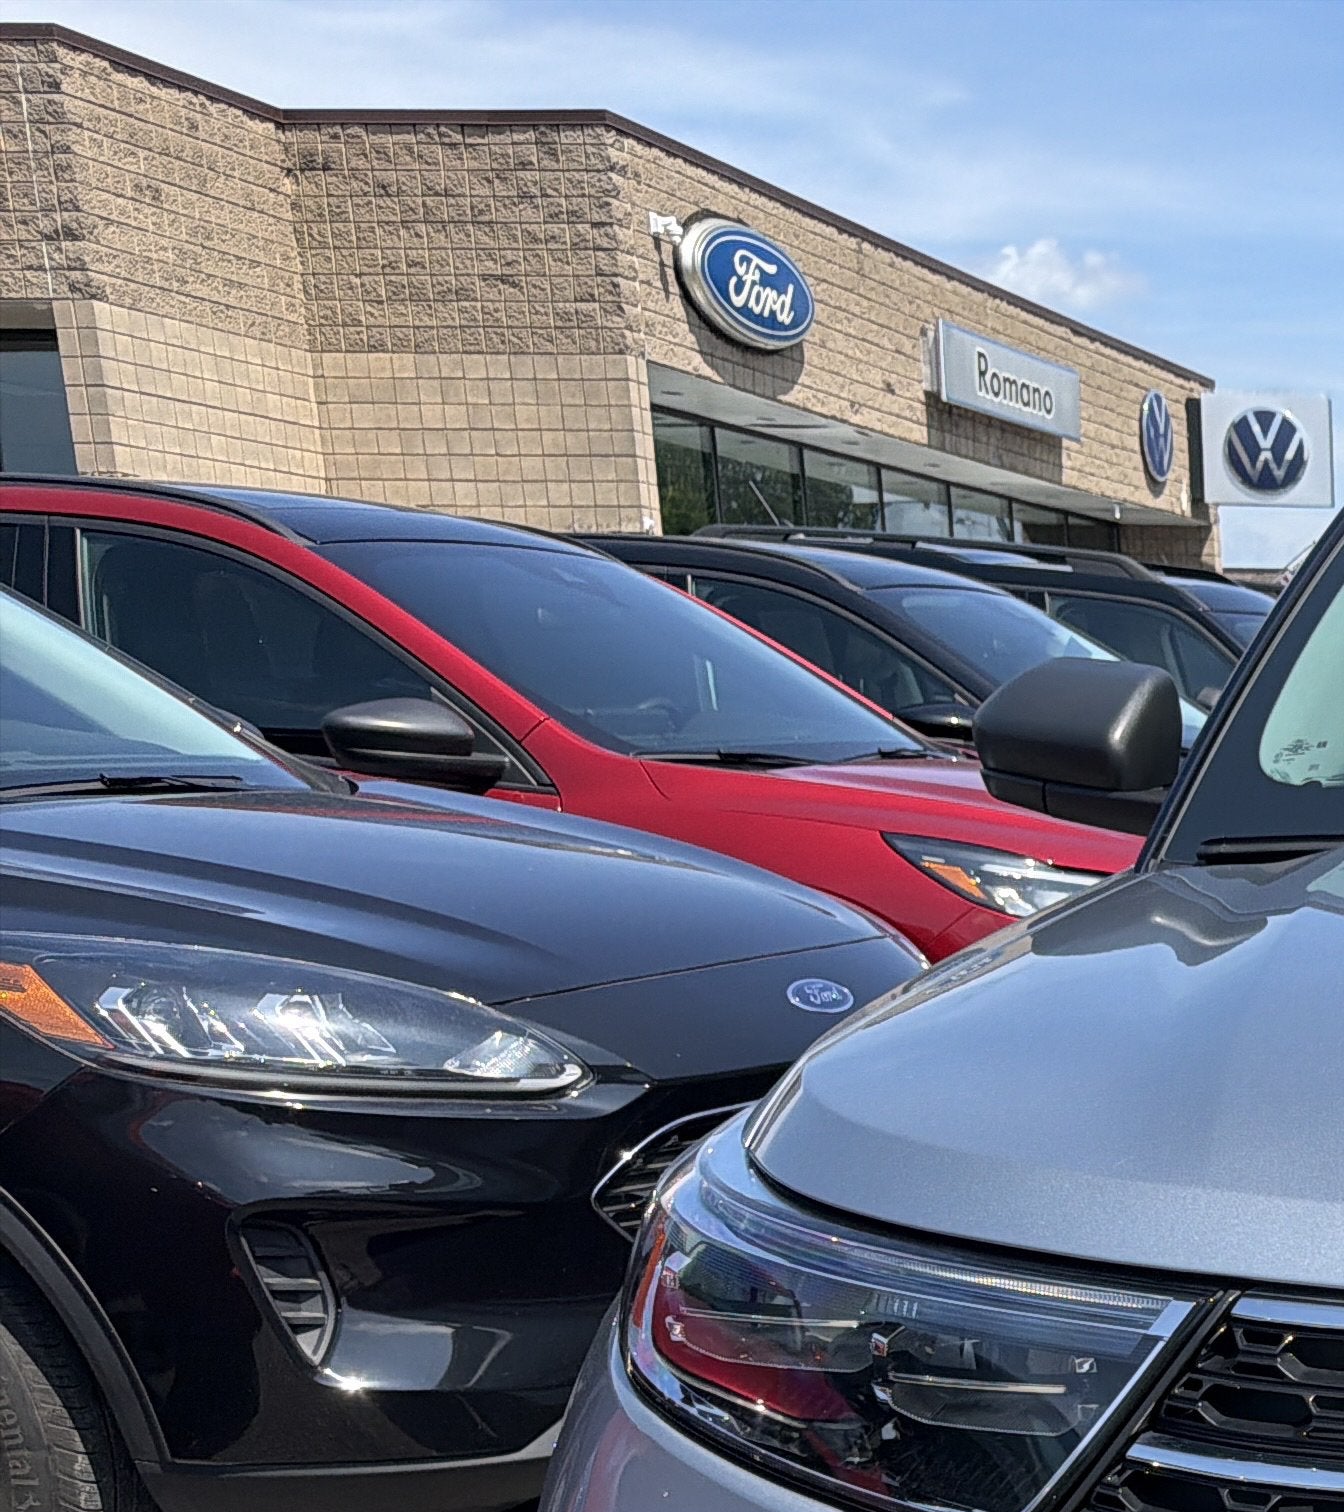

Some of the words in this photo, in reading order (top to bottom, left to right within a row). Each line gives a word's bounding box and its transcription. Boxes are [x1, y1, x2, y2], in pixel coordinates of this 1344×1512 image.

[729, 249, 795, 325] Ford
[976, 349, 1054, 416] Romano
[804, 983, 842, 1004] Ford
